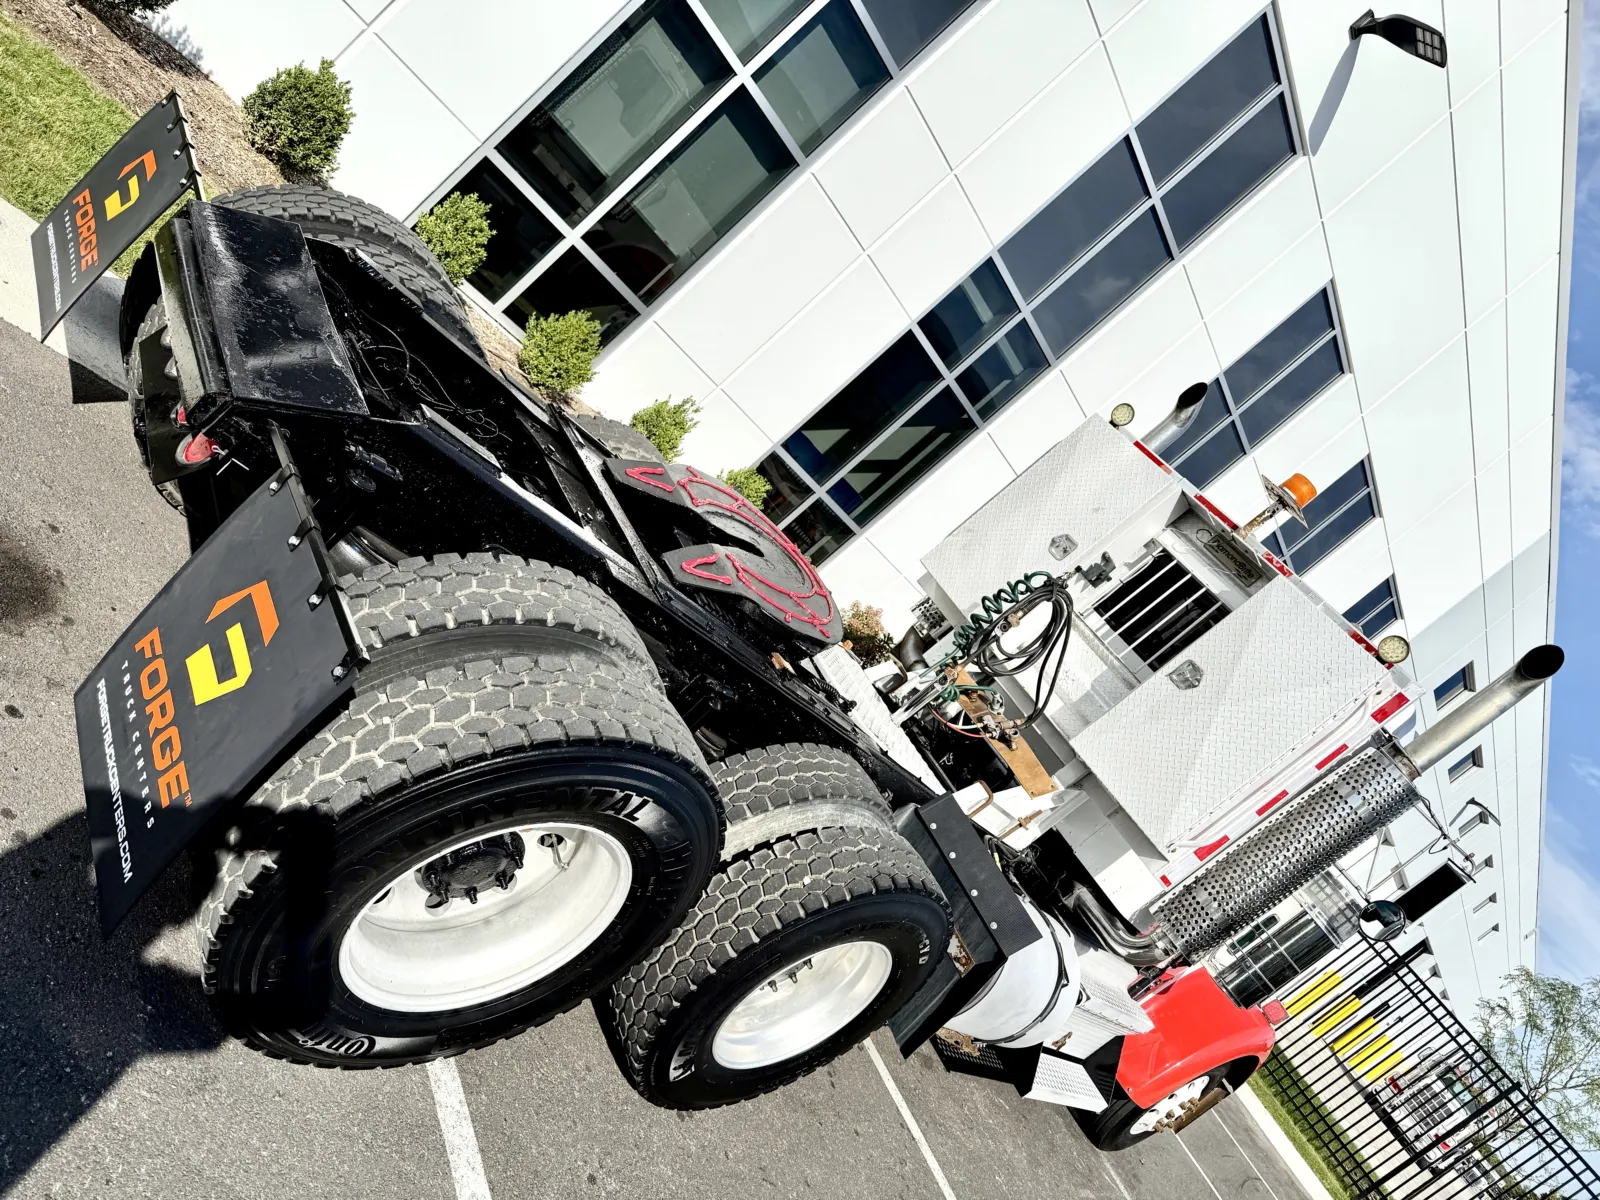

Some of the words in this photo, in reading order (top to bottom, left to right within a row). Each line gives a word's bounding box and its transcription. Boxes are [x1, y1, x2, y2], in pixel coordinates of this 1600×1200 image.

[96, 678, 133, 884] FORGETRUCKCENTERS.COM
[121, 660, 136, 722] TRUCK
[132, 731, 155, 829] CENTERS
[327, 786, 656, 903] ONTINENTAL
